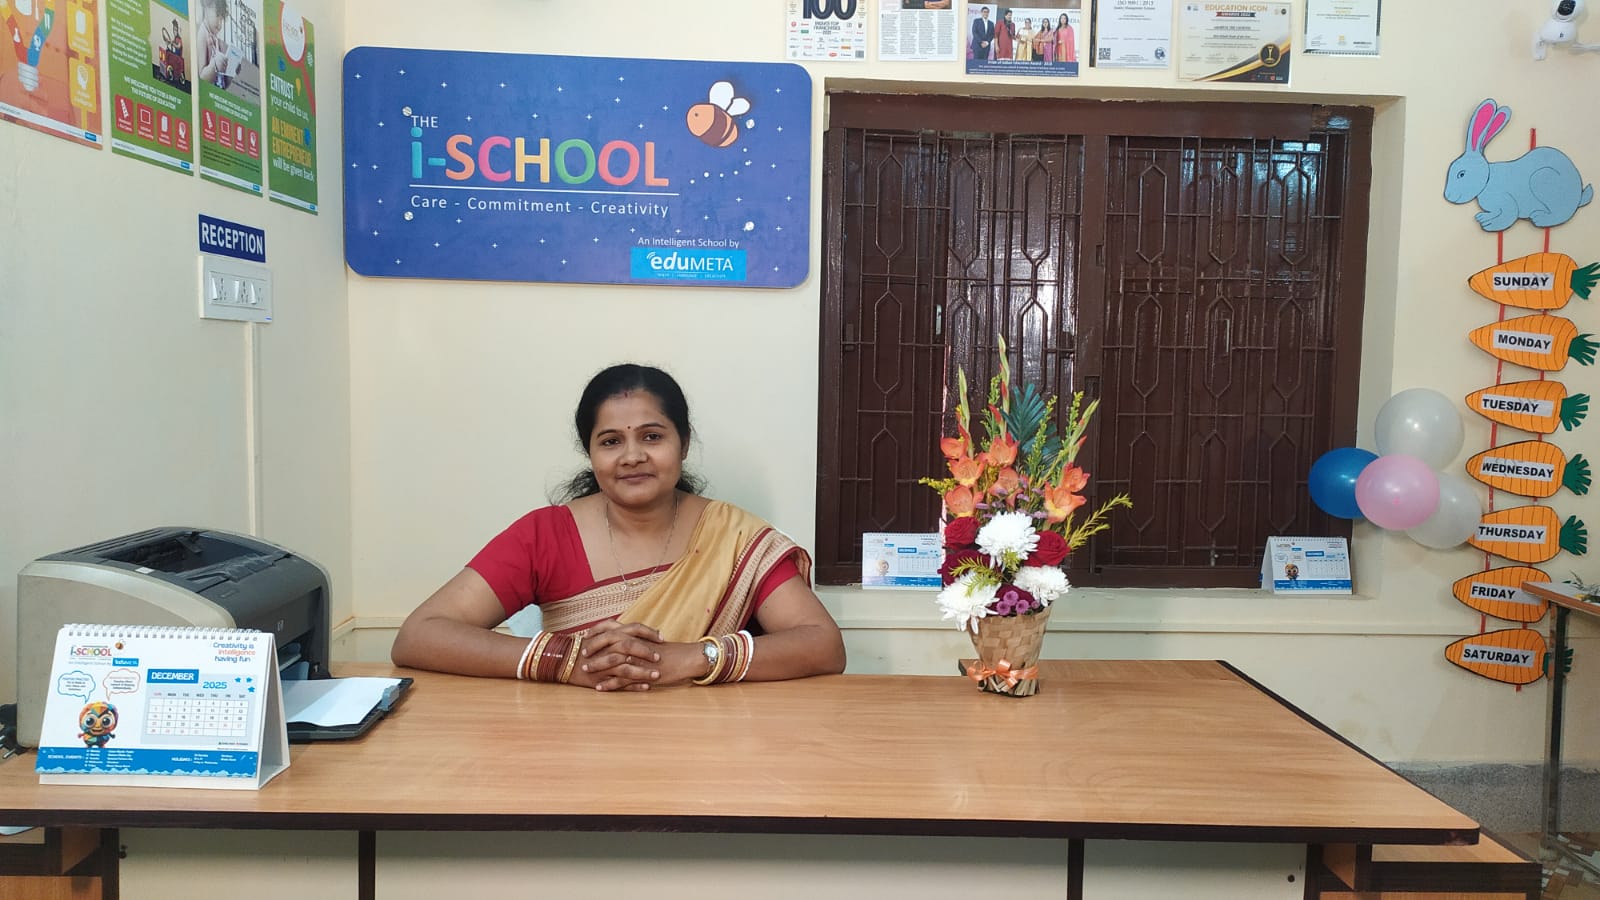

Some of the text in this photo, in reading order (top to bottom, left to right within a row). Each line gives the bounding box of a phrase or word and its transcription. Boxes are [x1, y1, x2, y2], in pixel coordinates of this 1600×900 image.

[1249, 4, 1268, 12] ICON
[270, 72, 294, 101] ENTRUST
[270, 94, 282, 107] your
[282, 100, 296, 114] child
[411, 115, 439, 128] THE
[410, 126, 670, 187] i-SCHOOL
[272, 156, 282, 169] will
[282, 158, 290, 172] be
[303, 167, 314, 182] back
[411, 195, 447, 209] Care
[467, 197, 571, 213] Commitment
[591, 201, 670, 218] Creativity
[201, 222, 263, 255] RECEPTION
[638, 237, 740, 249] An Intelligent School by
[650, 251, 734, 272] eduMETA
[1494, 276, 1549, 287] SUNDAY
[1498, 334, 1552, 350] MONDAY
[1482, 398, 1539, 413] TUESDAY
[1482, 461, 1554, 478] WEDNESDAY
[1478, 525, 1544, 540] THURSDAY
[1471, 585, 1516, 600] FRIDAY
[213, 642, 248, 650] Creativity
[214, 655, 238, 663] having
[1463, 648, 1530, 664] SATURDAY
[151, 672, 195, 681] DECEMBER
[202, 681, 228, 689] 2025
